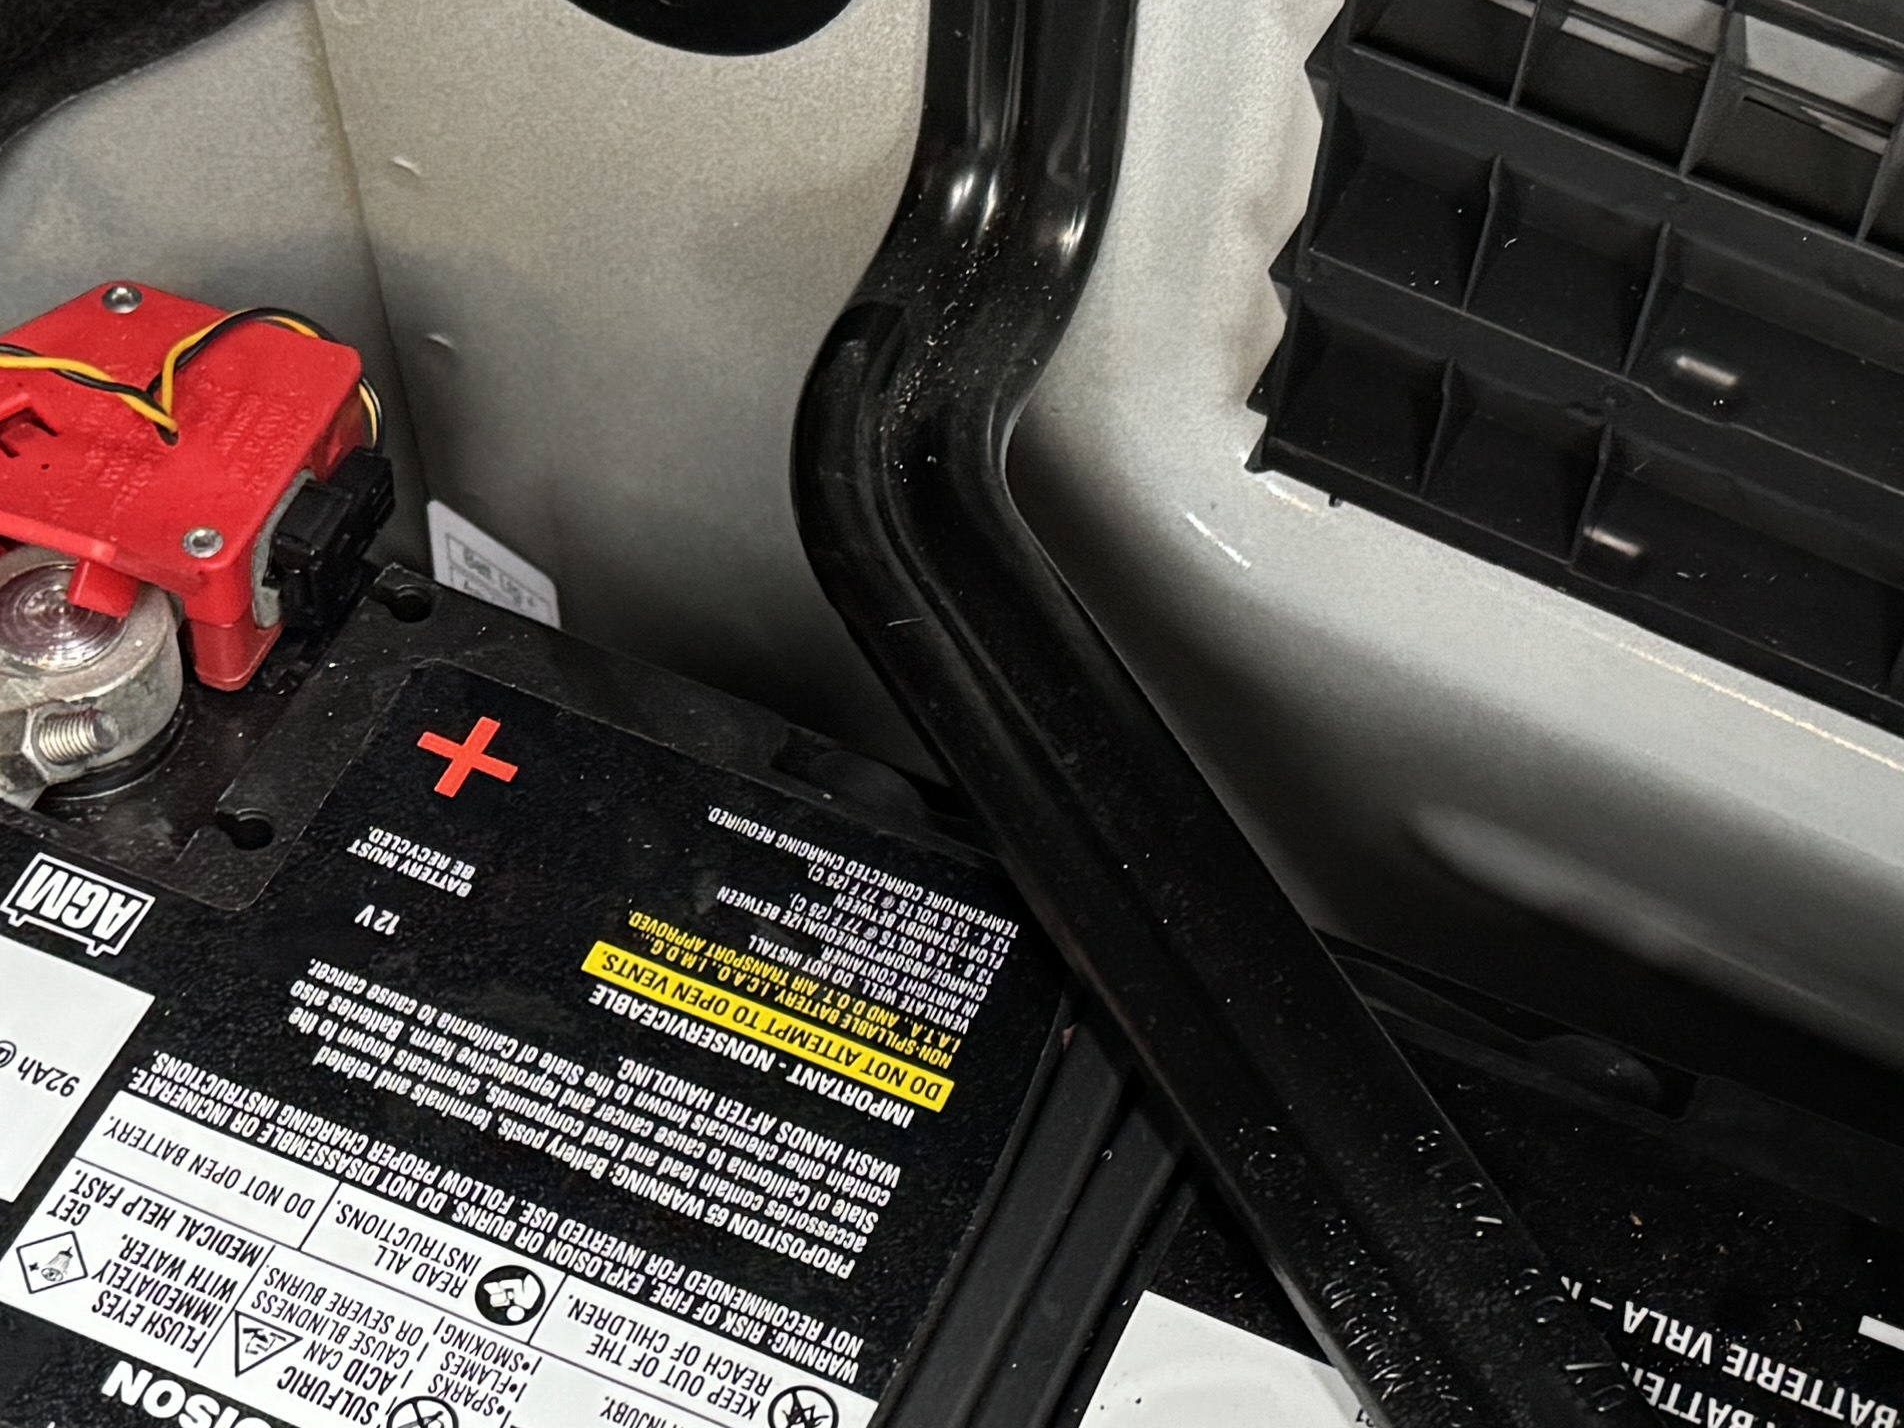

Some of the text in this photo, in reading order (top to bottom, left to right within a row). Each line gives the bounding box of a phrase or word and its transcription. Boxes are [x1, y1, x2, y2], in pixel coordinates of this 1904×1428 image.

[346, 838, 472, 897] BATTERY MUST
[367, 825, 476, 880] BE RECYCLED.
[774, 833, 845, 870] CHARGING
[844, 859, 924, 901] CORRECTED
[15, 864, 141, 940] AGM
[353, 903, 400, 935] 12 V
[922, 890, 1019, 939] TEMPERATURE
[747, 933, 803, 968] INSTALL
[800, 956, 833, 980] NOT
[830, 967, 855, 989] DO
[588, 983, 776, 1072] NONSERVICEABLE
[601, 950, 943, 1101] DO NOT ATTEMPT TO OPEN VENTS.
[897, 994, 970, 1035] VENTILATE
[17, 1056, 80, 1097] 92Ah
[289, 979, 879, 1234] State of California to cause cancer and reproductive harm. Batteries also
[785, 1063, 914, 1128] IMPORTANT
[616, 1055, 901, 1188] WASH HANDS AFTER HANDLING.
[102, 1115, 316, 1219] DO NOT OPEN BATTERY.
[311, 1044, 855, 1279] PROPOSITION 65 WARNING: Battery posts, terminals and related
[45, 1193, 91, 1226] GET
[68, 1169, 264, 1268] MEDICAL HELP FAST.
[127, 1066, 859, 1384] WARNING: RISK OF FIRE, EXPLOSION OR BURNS. DO NOT DISASSEMBLE OR INCINERATE.
[150, 1049, 864, 1359] NOT RECOMMENDED FOR INVERTED USE. FOLLOW PROPER CHARGING INSTRUCTIONS.
[118, 1233, 238, 1304] WITH WATER.
[334, 1199, 481, 1276] INSTRUCTIONS.
[91, 1258, 223, 1328] IMMEDIATELY
[373, 1243, 468, 1299] READ ALL
[90, 1289, 207, 1353] FLUSH EYES
[250, 1289, 410, 1370] CAUSE BLINDNESS
[263, 1264, 424, 1347] OR SEVERE BURNS.
[1622, 1300, 1712, 1364] VRLA
[302, 1339, 398, 1396] ACID CAN
[566, 1294, 773, 1397] REACH OF CHILDREN.
[585, 1333, 761, 1420] KEEP OUT OF THE
[276, 1365, 379, 1425] SULFURIC
